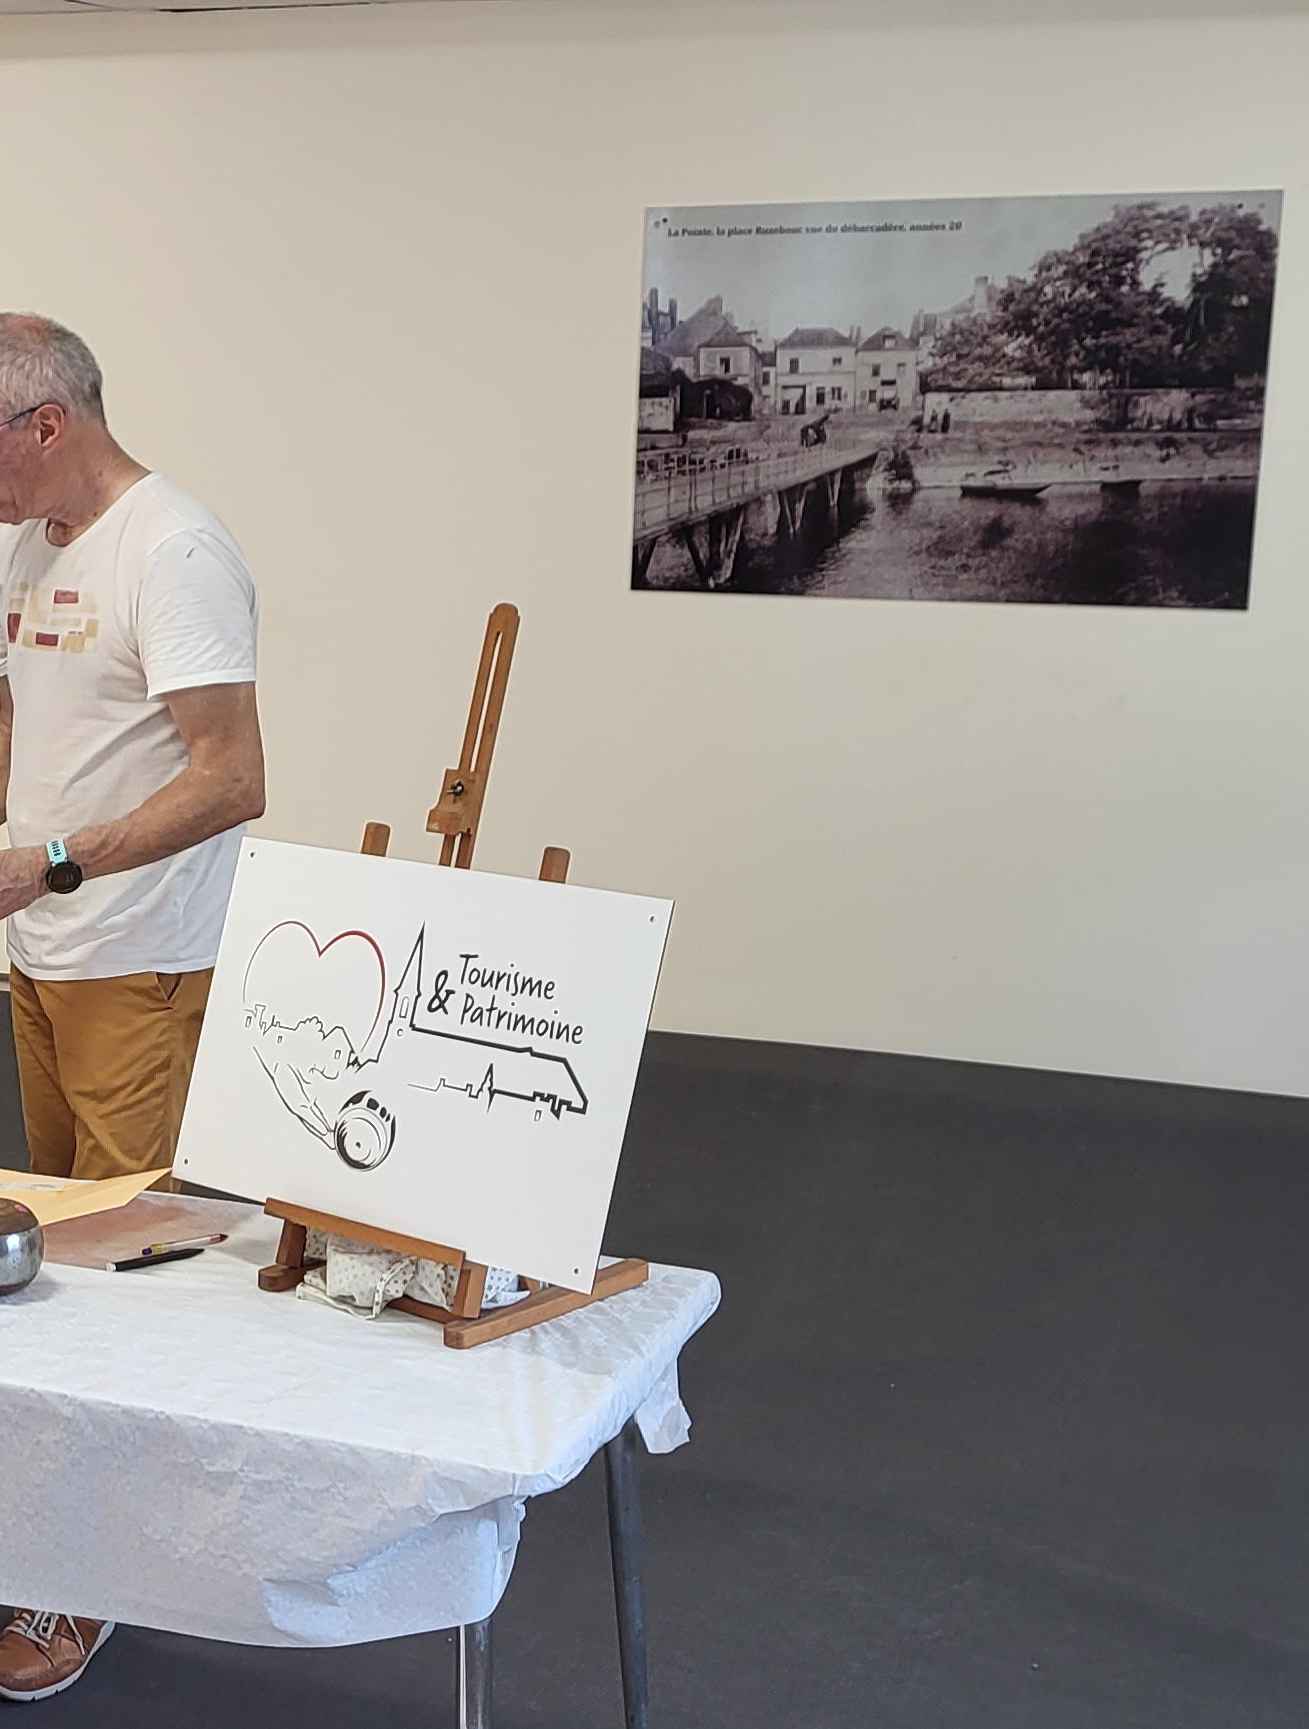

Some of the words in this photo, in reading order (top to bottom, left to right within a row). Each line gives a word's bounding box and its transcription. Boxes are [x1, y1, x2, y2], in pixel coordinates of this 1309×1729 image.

[667, 227, 679, 237] La
[681, 228, 714, 236] Pointe,
[716, 226, 725, 236] la
[727, 226, 752, 237] place
[825, 224, 838, 233] du
[909, 222, 946, 232] années
[458, 953, 556, 1000] Tourisme
[426, 969, 457, 1015] &
[459, 991, 584, 1045] Patrimoine
